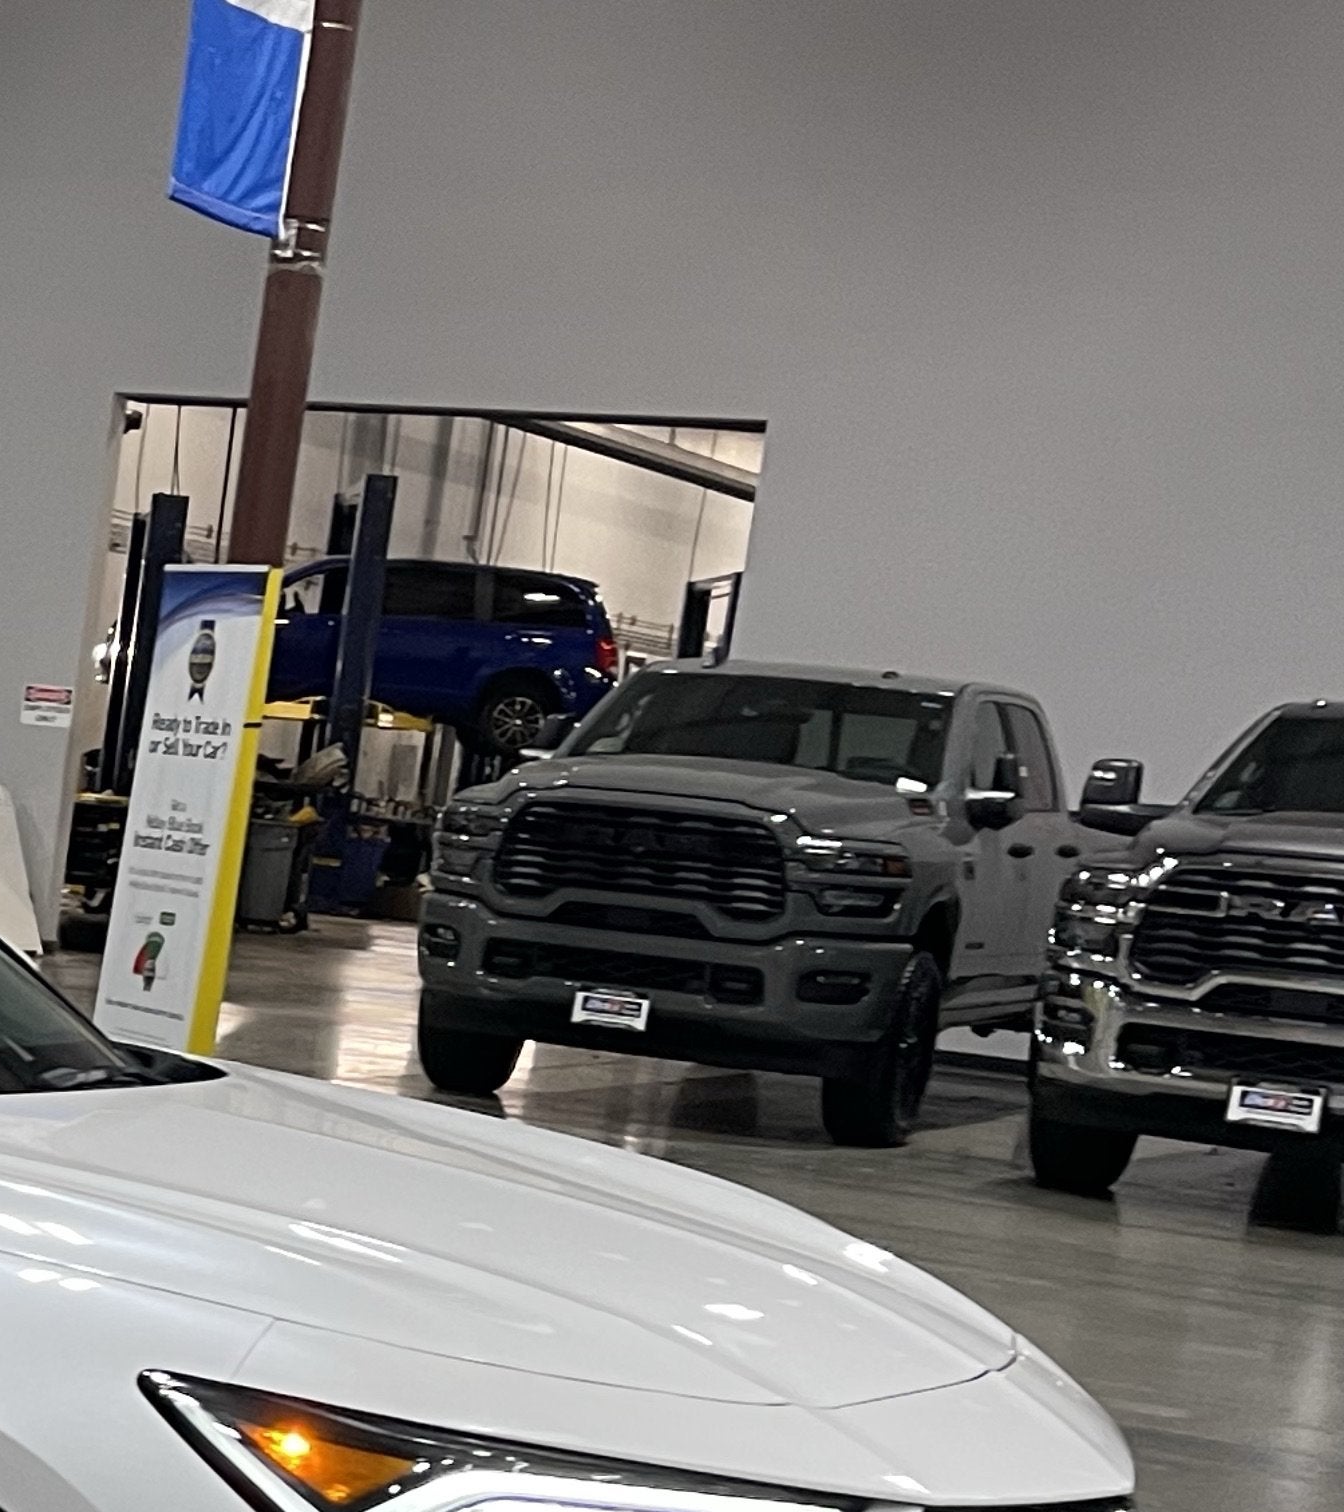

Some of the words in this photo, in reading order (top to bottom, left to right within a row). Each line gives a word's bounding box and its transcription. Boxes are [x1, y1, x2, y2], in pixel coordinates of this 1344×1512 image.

[151, 712, 180, 736] Ready
[182, 717, 192, 733] to
[194, 716, 219, 736] Trade
[148, 740, 162, 753] or
[162, 737, 179, 756] Sell
[181, 738, 203, 757] Your
[1227, 893, 1344, 927] RA
